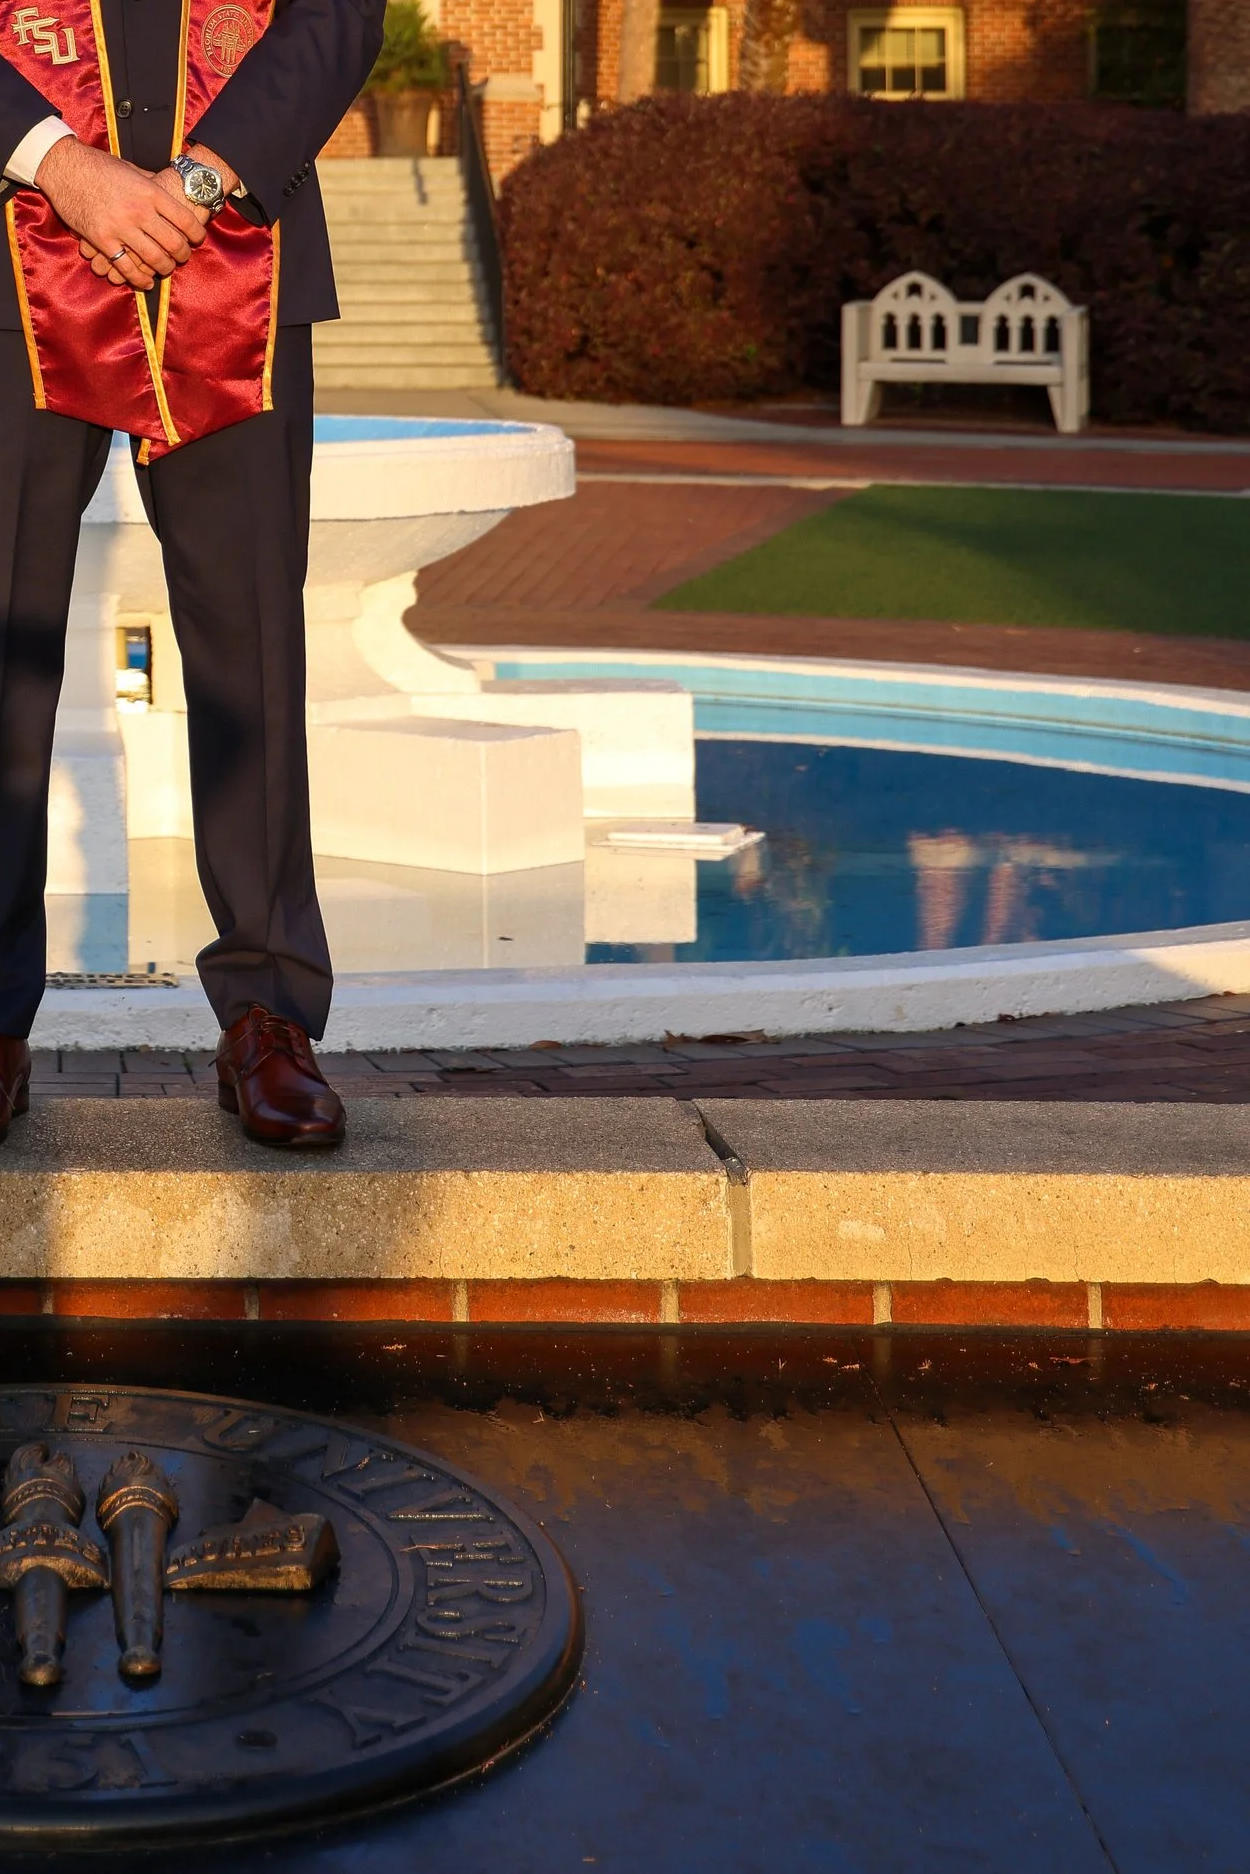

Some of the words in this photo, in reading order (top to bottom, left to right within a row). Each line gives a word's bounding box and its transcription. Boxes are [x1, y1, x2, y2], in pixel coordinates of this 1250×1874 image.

[11, 6, 80, 65] FSU
[205, 18, 218, 56] FLORIDA
[218, 9, 240, 19] STATE
[202, 1408, 534, 1750] UNIVERSITY
